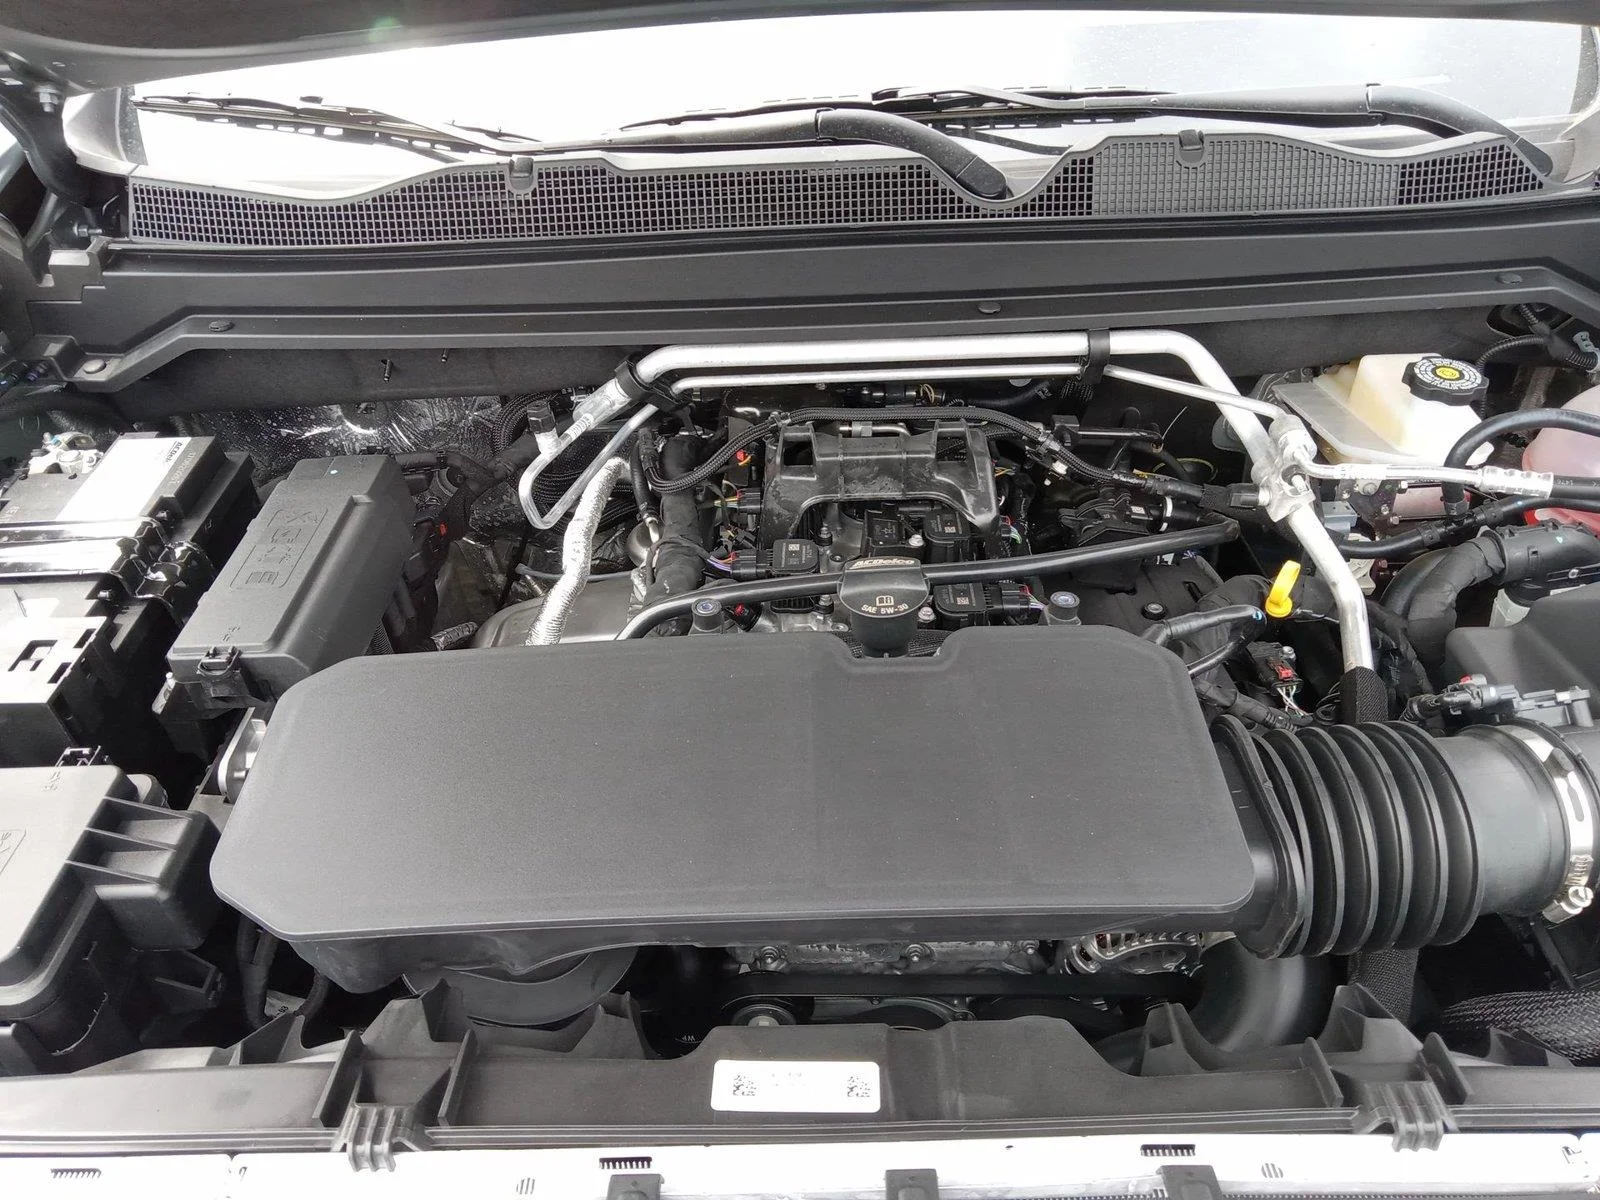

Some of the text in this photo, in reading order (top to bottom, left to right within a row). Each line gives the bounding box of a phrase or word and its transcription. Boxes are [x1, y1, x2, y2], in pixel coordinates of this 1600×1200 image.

[849, 558, 915, 570] ACDelco
[861, 603, 909, 614] SAE 5W-30
